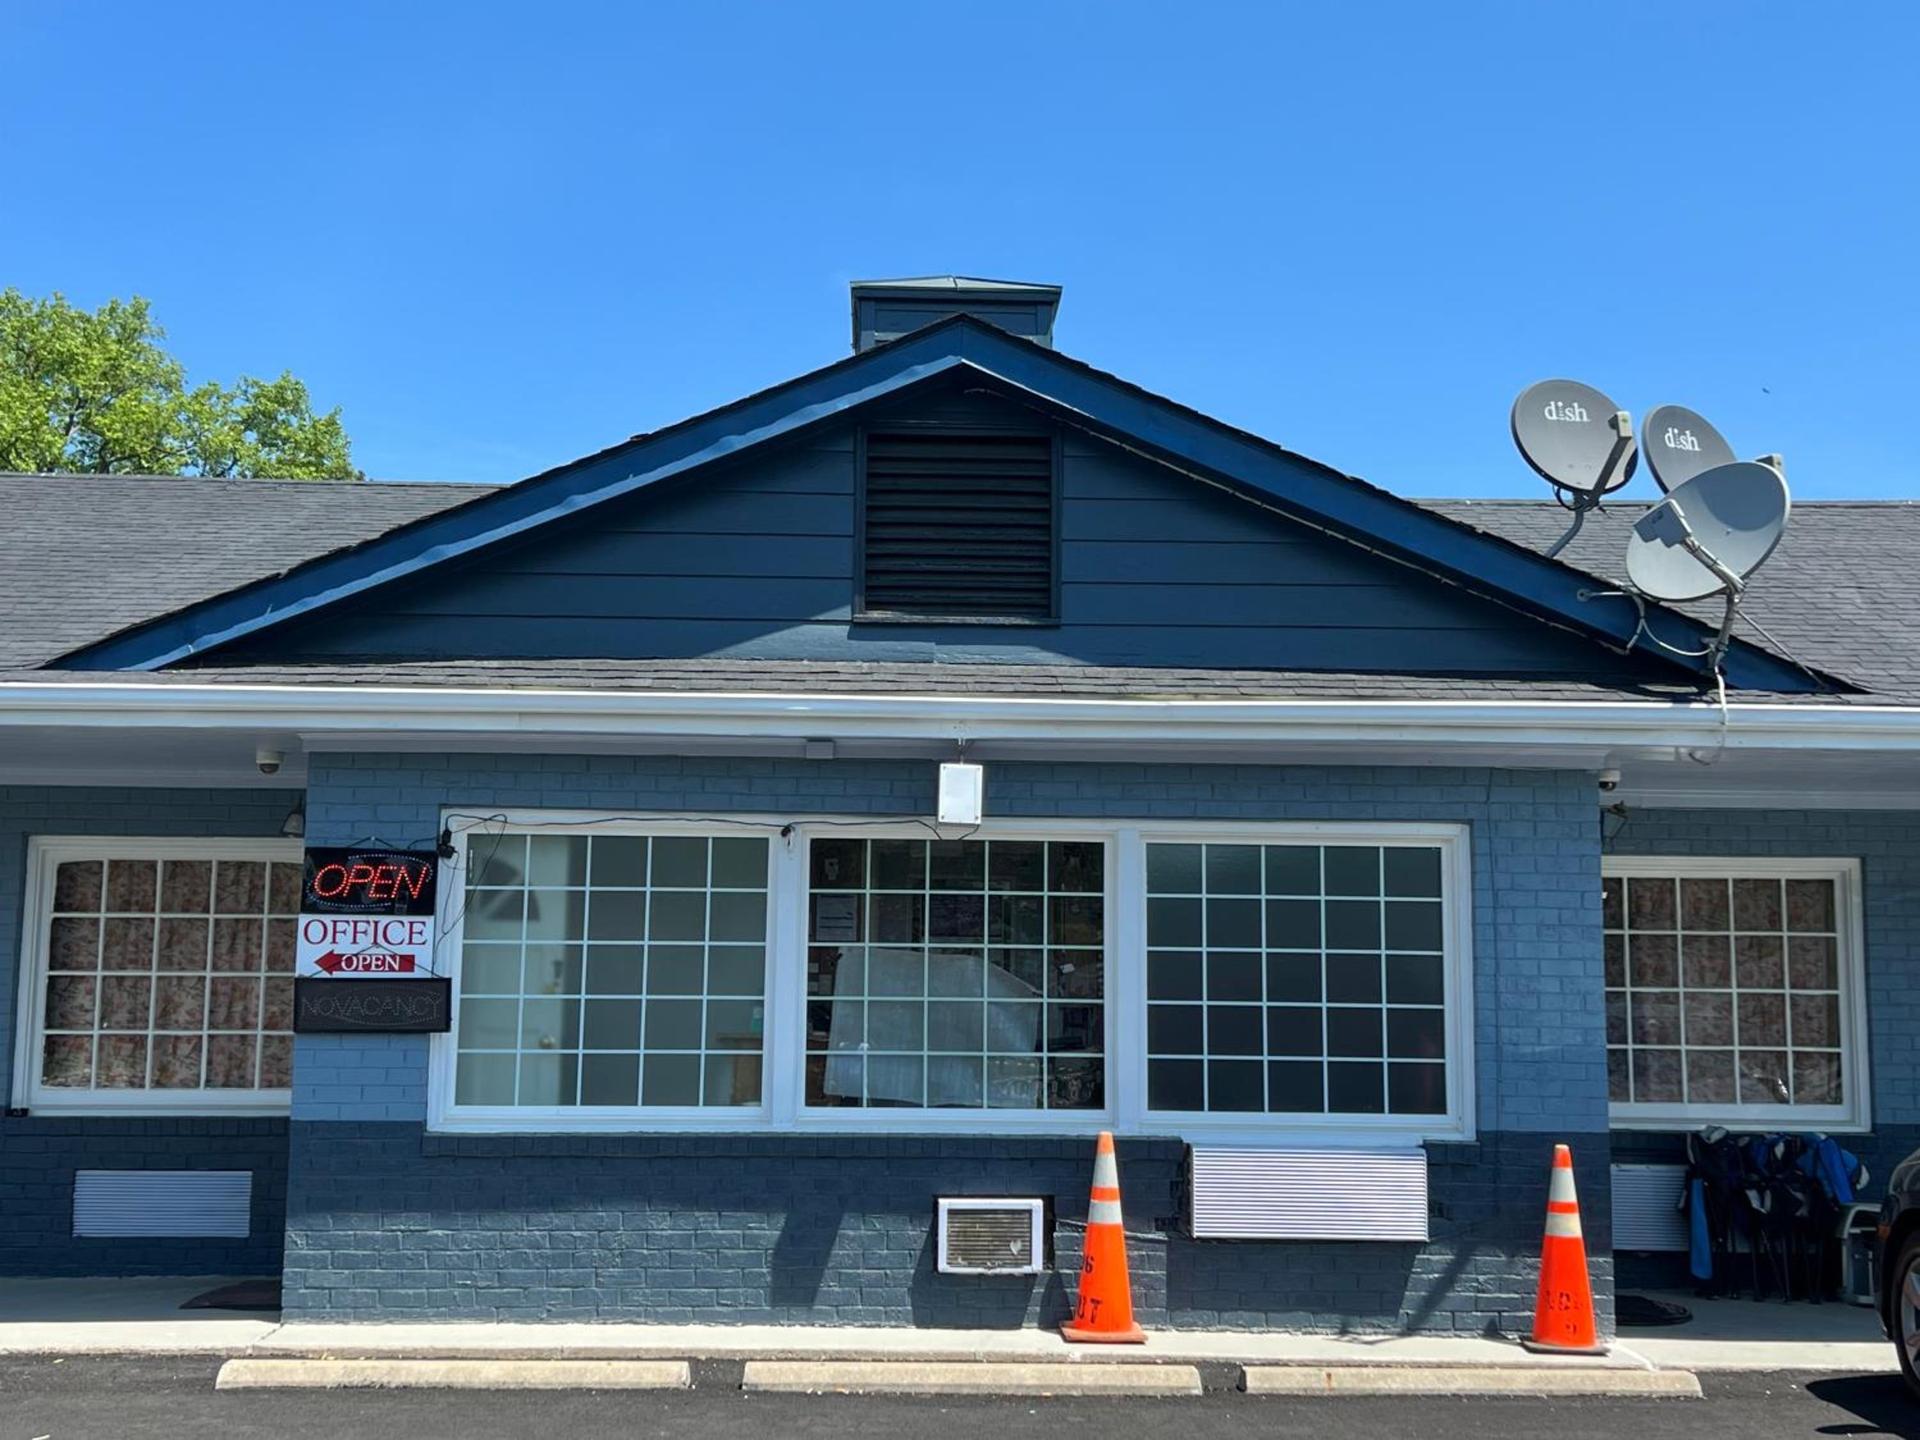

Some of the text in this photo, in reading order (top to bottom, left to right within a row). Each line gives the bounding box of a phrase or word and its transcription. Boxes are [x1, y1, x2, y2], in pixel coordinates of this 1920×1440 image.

[1544, 401, 1588, 423] dish
[1664, 427, 1701, 451] dish
[313, 863, 429, 899] OPEN
[303, 918, 428, 946] OFFICE
[340, 953, 400, 972] OPEN
